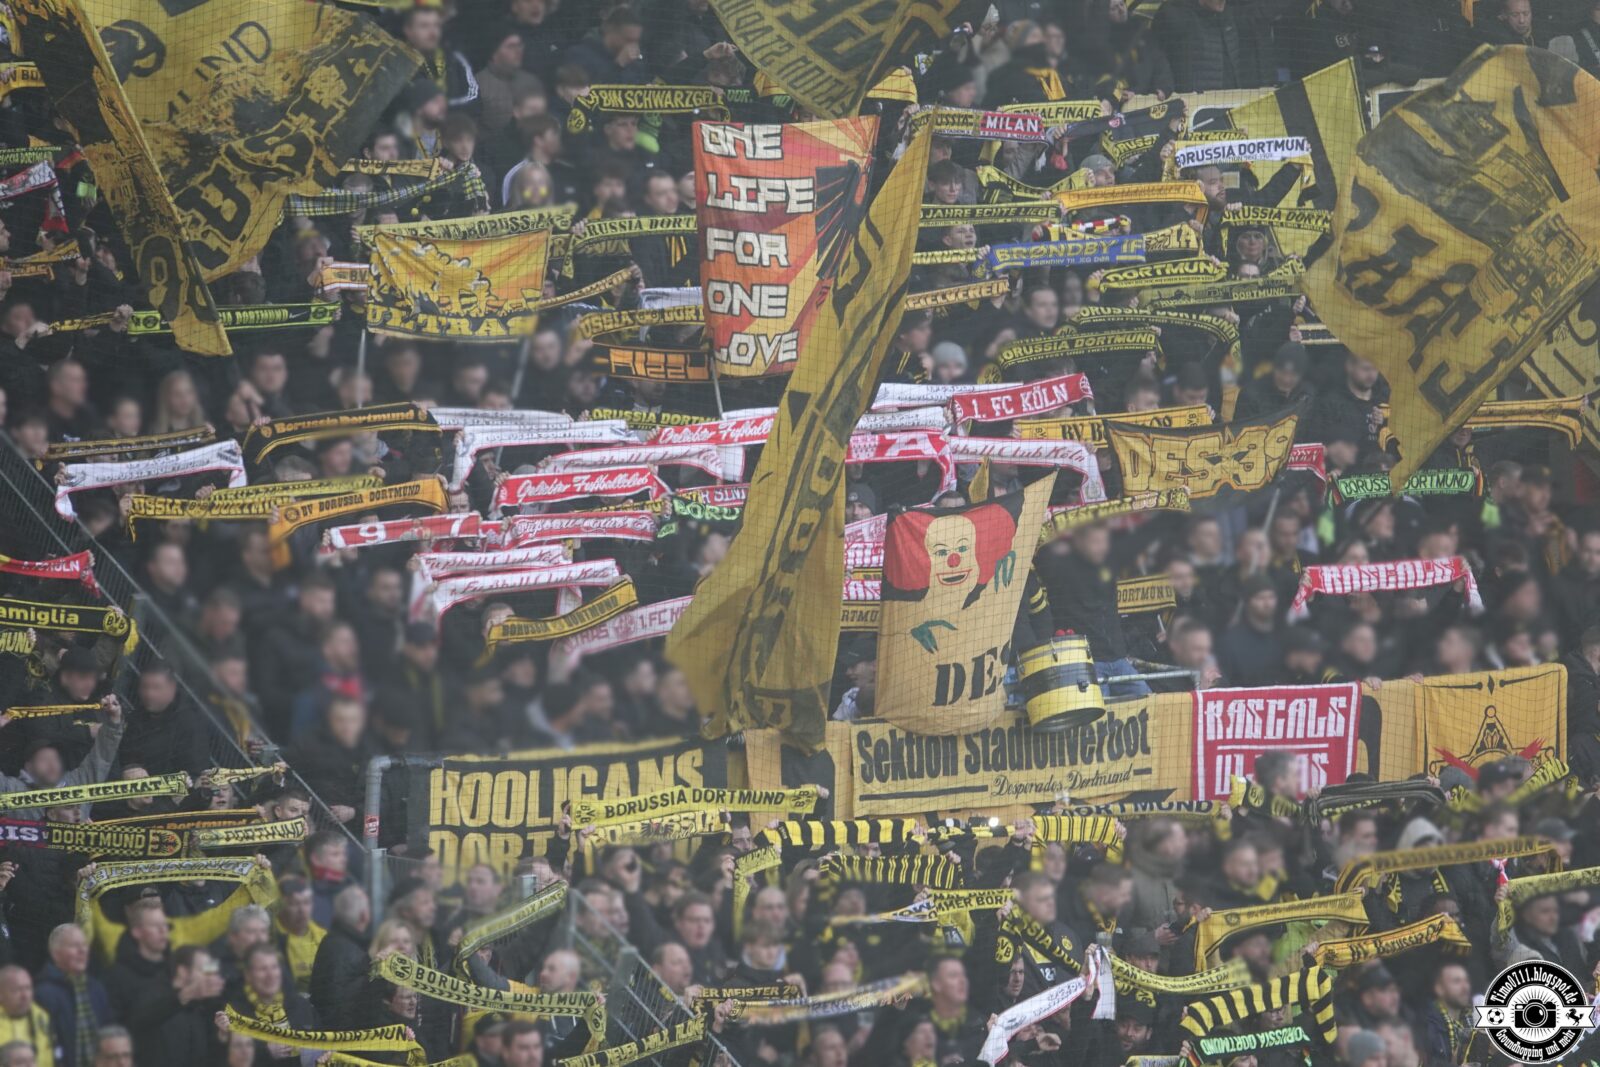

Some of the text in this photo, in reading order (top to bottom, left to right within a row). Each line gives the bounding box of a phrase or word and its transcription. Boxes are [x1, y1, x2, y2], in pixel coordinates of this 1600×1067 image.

[602, 88, 724, 107] BIN SCHWARZGEL
[985, 116, 1039, 133] MILAN
[700, 123, 783, 160] ONE
[1239, 139, 1311, 158] DORTMUN
[707, 173, 815, 214] LIFE
[650, 216, 697, 230] DORT
[925, 208, 972, 219] JAHRE
[975, 207, 1017, 218] ECHTE
[706, 227, 790, 267] FOR
[995, 239, 1118, 263] BRØNDBY
[1121, 238, 1144, 254] IF
[707, 280, 789, 318] ONE
[1074, 333, 1155, 349] DORTMUND
[971, 398, 986, 419] 1.
[991, 395, 1015, 416] FC
[1020, 383, 1069, 413] KÖLN
[318, 494, 364, 511] BORUSSIA
[369, 484, 421, 503] DORTMUND
[0, 607, 79, 626] amiglia
[841, 609, 880, 623] RTMU
[932, 645, 1008, 707] DE
[1205, 696, 1349, 742] RASCALS
[856, 706, 1152, 785] Sektion Stadionverbot
[11, 780, 162, 805] UNSERE HEIMAT
[429, 748, 705, 828] HOOLIGANS
[991, 763, 1133, 797] Desperados Dortmund
[605, 788, 688, 819] BORUSSIA
[692, 787, 785, 806] DORTMUND
[52, 828, 146, 850] DORTMUND
[415, 966, 505, 1002] BORUSSIA
[721, 986, 779, 998] MEISTER
[333, 1027, 410, 1042] DORTMUN
